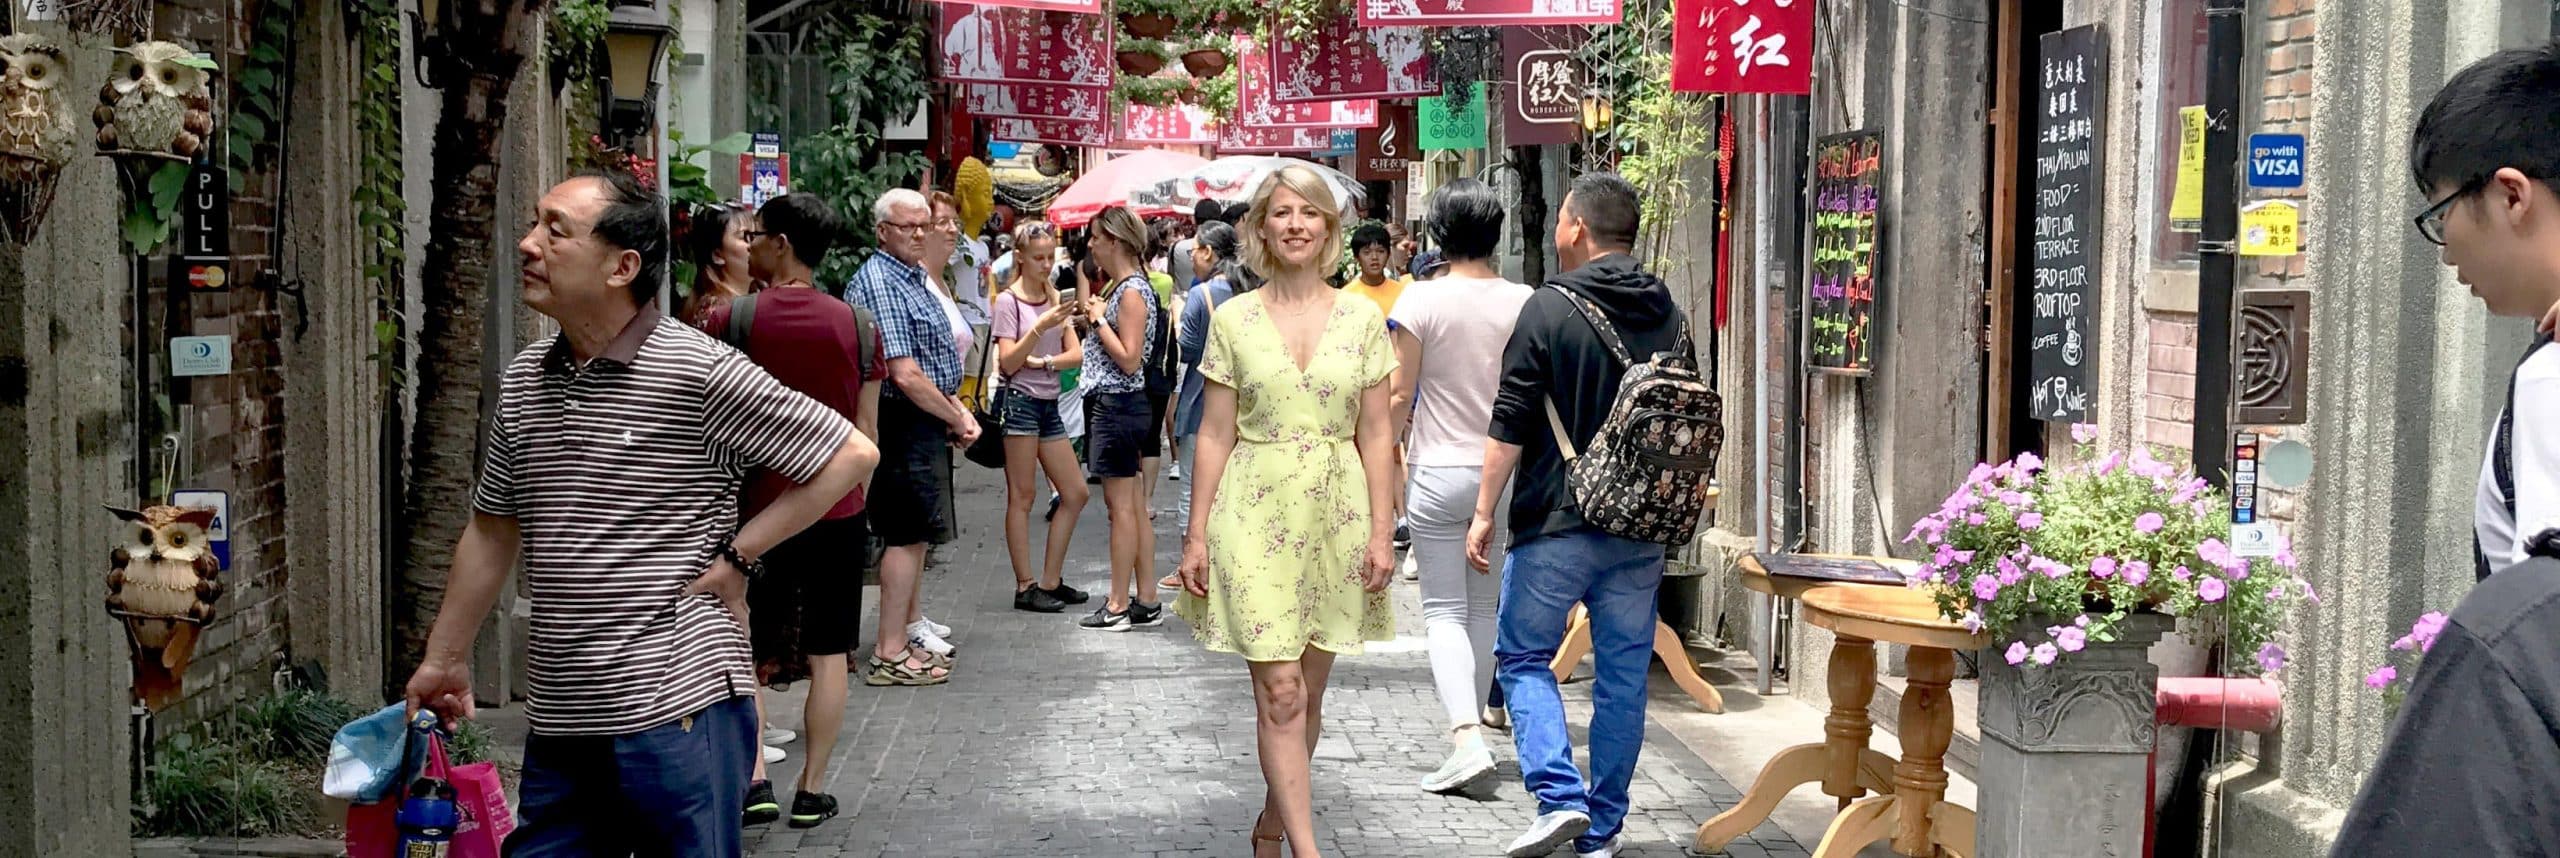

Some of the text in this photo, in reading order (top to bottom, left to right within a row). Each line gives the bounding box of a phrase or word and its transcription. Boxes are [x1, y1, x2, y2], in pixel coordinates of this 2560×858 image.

[1698, 6, 1729, 76] Wine
[1730, 14, 1790, 77] 红
[2255, 146, 2297, 158] go with
[2252, 159, 2299, 175] VISA
[198, 173, 213, 252] PULL
[2035, 213, 2075, 238] 2ND FLOOR
[2036, 237, 2080, 260] TERRACE
[2034, 265, 2088, 290] 3RD FLOOR
[2034, 292, 2081, 319] ROOFTOP
[2032, 333, 2059, 350] COFFEE
[2032, 376, 2087, 416] HOT WINE
